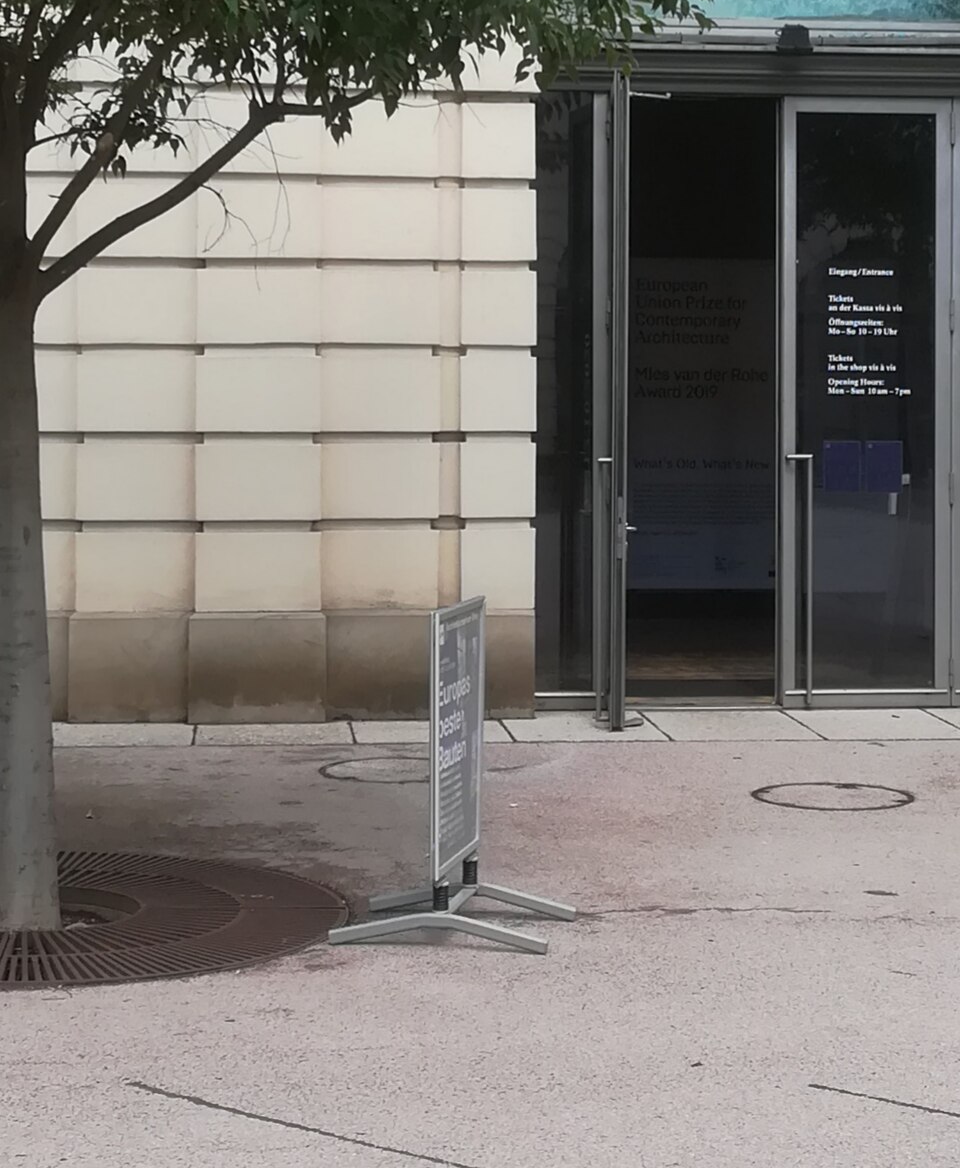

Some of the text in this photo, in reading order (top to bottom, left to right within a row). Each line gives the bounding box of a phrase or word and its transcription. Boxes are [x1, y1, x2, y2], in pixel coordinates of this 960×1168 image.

[635, 278, 708, 293] European
[635, 295, 747, 310] Union Prize for
[828, 294, 854, 303] Tickets
[839, 303, 852, 312] der
[635, 313, 741, 329] Contemporary
[883, 327, 898, 336] Uhr
[635, 331, 730, 344] Architecture
[828, 354, 854, 362] Tickets
[837, 363, 849, 372] the
[850, 363, 867, 373] shop
[634, 367, 768, 382] Mies van der Rohe
[828, 377, 859, 387] Opening
[634, 384, 718, 399] Award 2019
